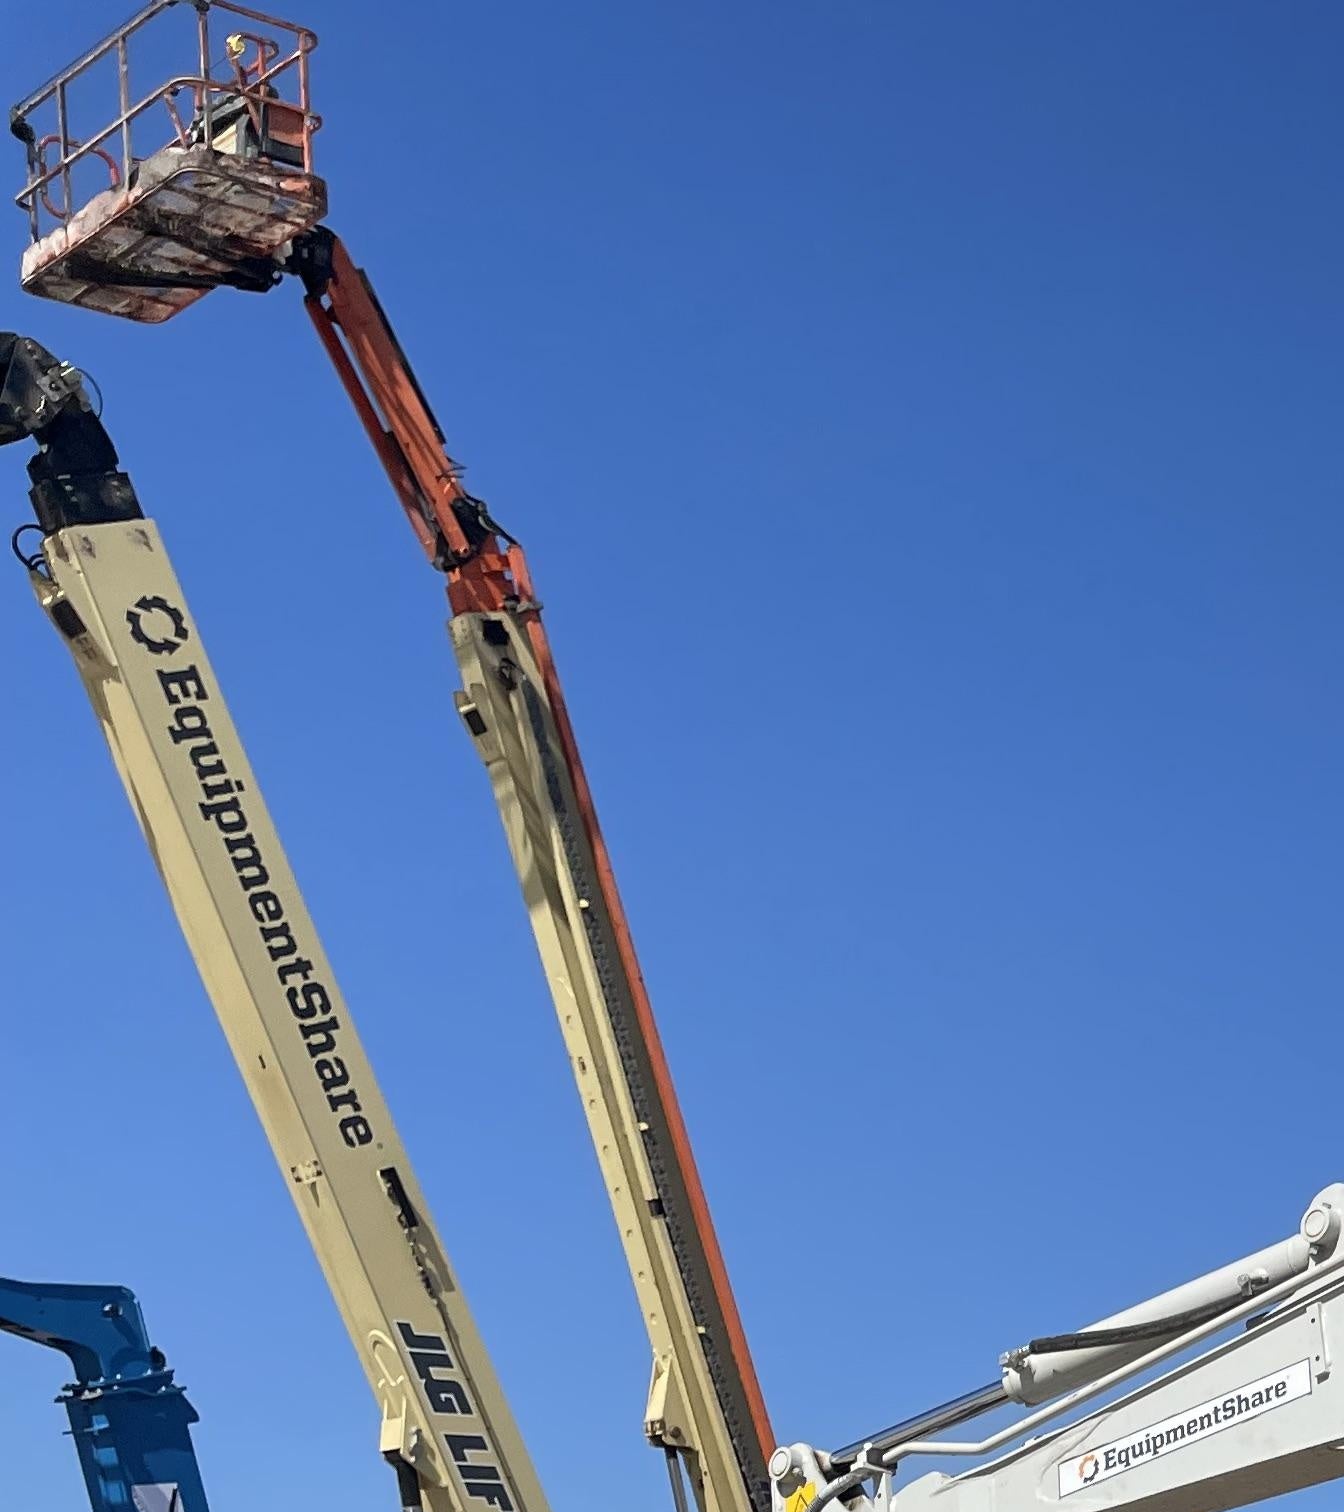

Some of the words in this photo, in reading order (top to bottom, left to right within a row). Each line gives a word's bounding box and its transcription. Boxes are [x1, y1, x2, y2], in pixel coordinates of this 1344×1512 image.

[156, 664, 374, 1149] EquipmentShare
[396, 1321, 474, 1415] JLG
[1104, 1380, 1287, 1471] EquipmentShare
